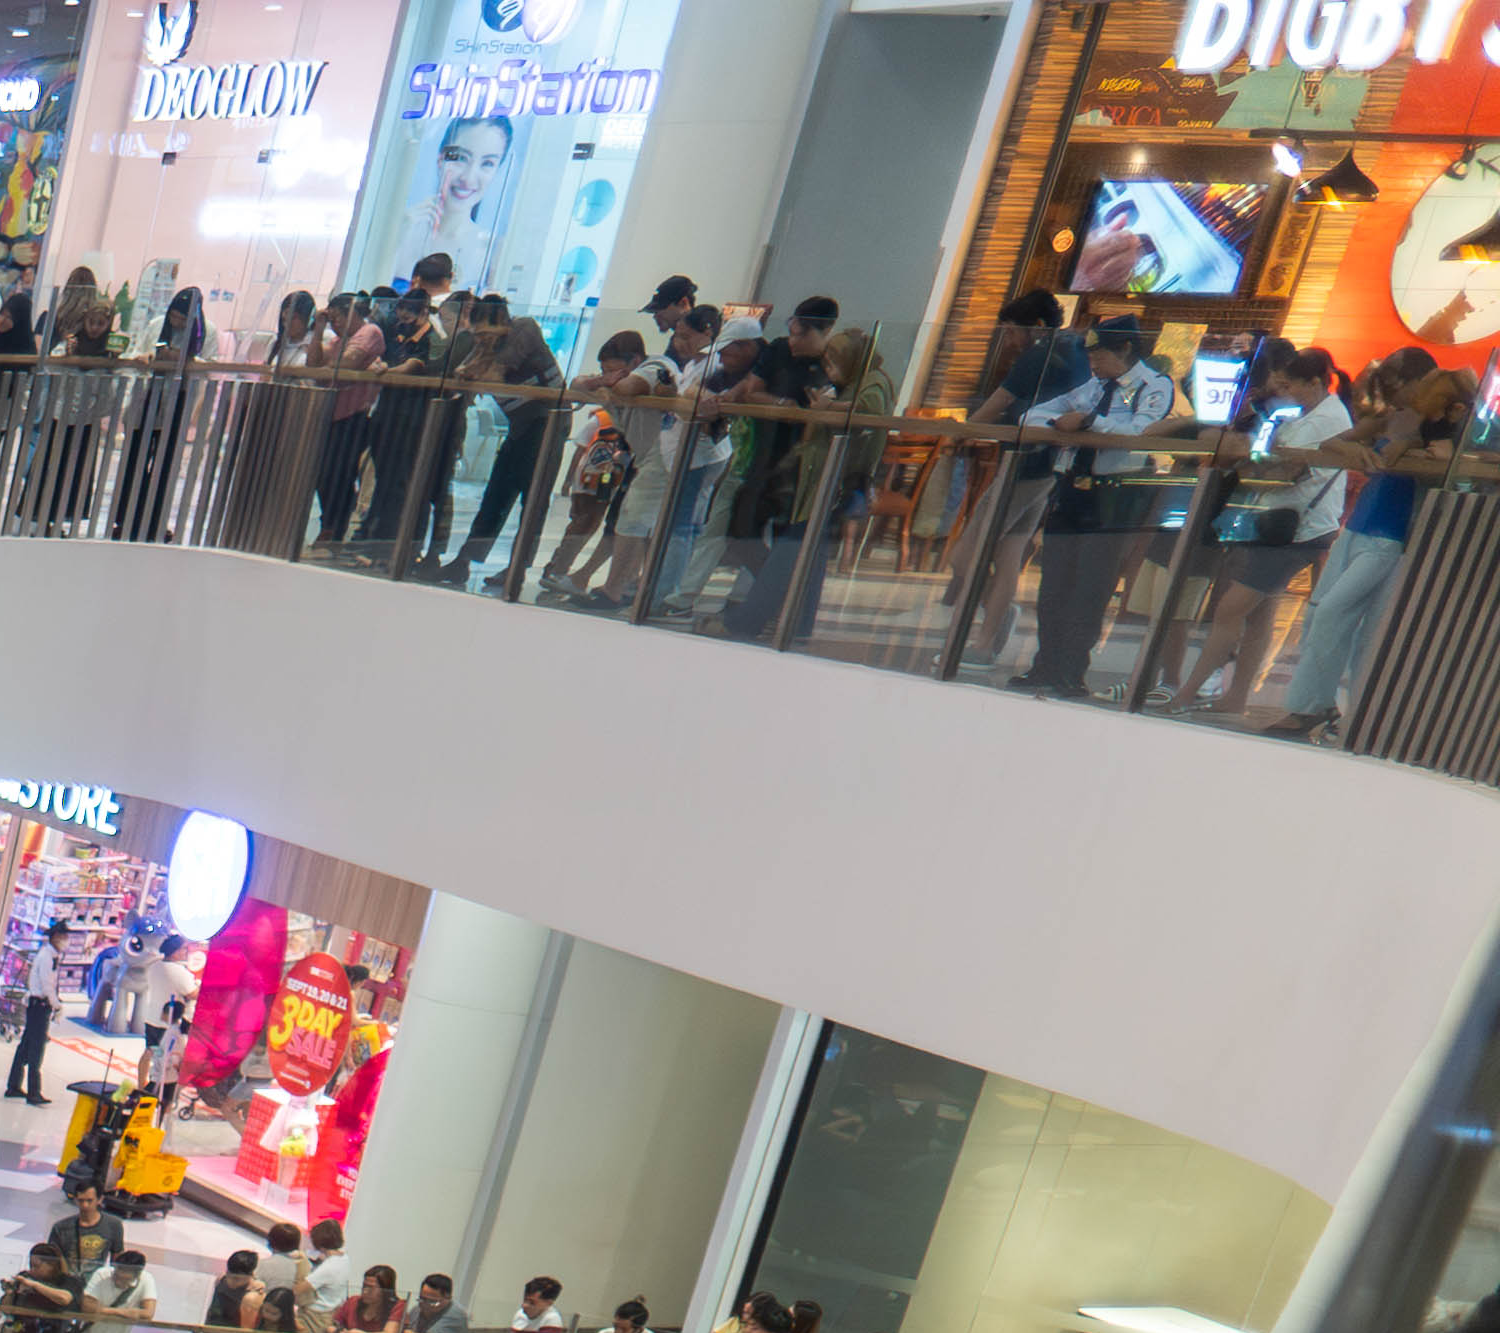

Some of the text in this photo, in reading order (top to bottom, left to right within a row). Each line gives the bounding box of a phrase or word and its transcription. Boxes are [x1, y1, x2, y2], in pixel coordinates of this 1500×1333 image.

[133, 61, 329, 122] DEOGLOW
[402, 58, 661, 120] SkinStation
[269, 995, 344, 1052] 3 DAY
[286, 1029, 338, 1071] SALE
